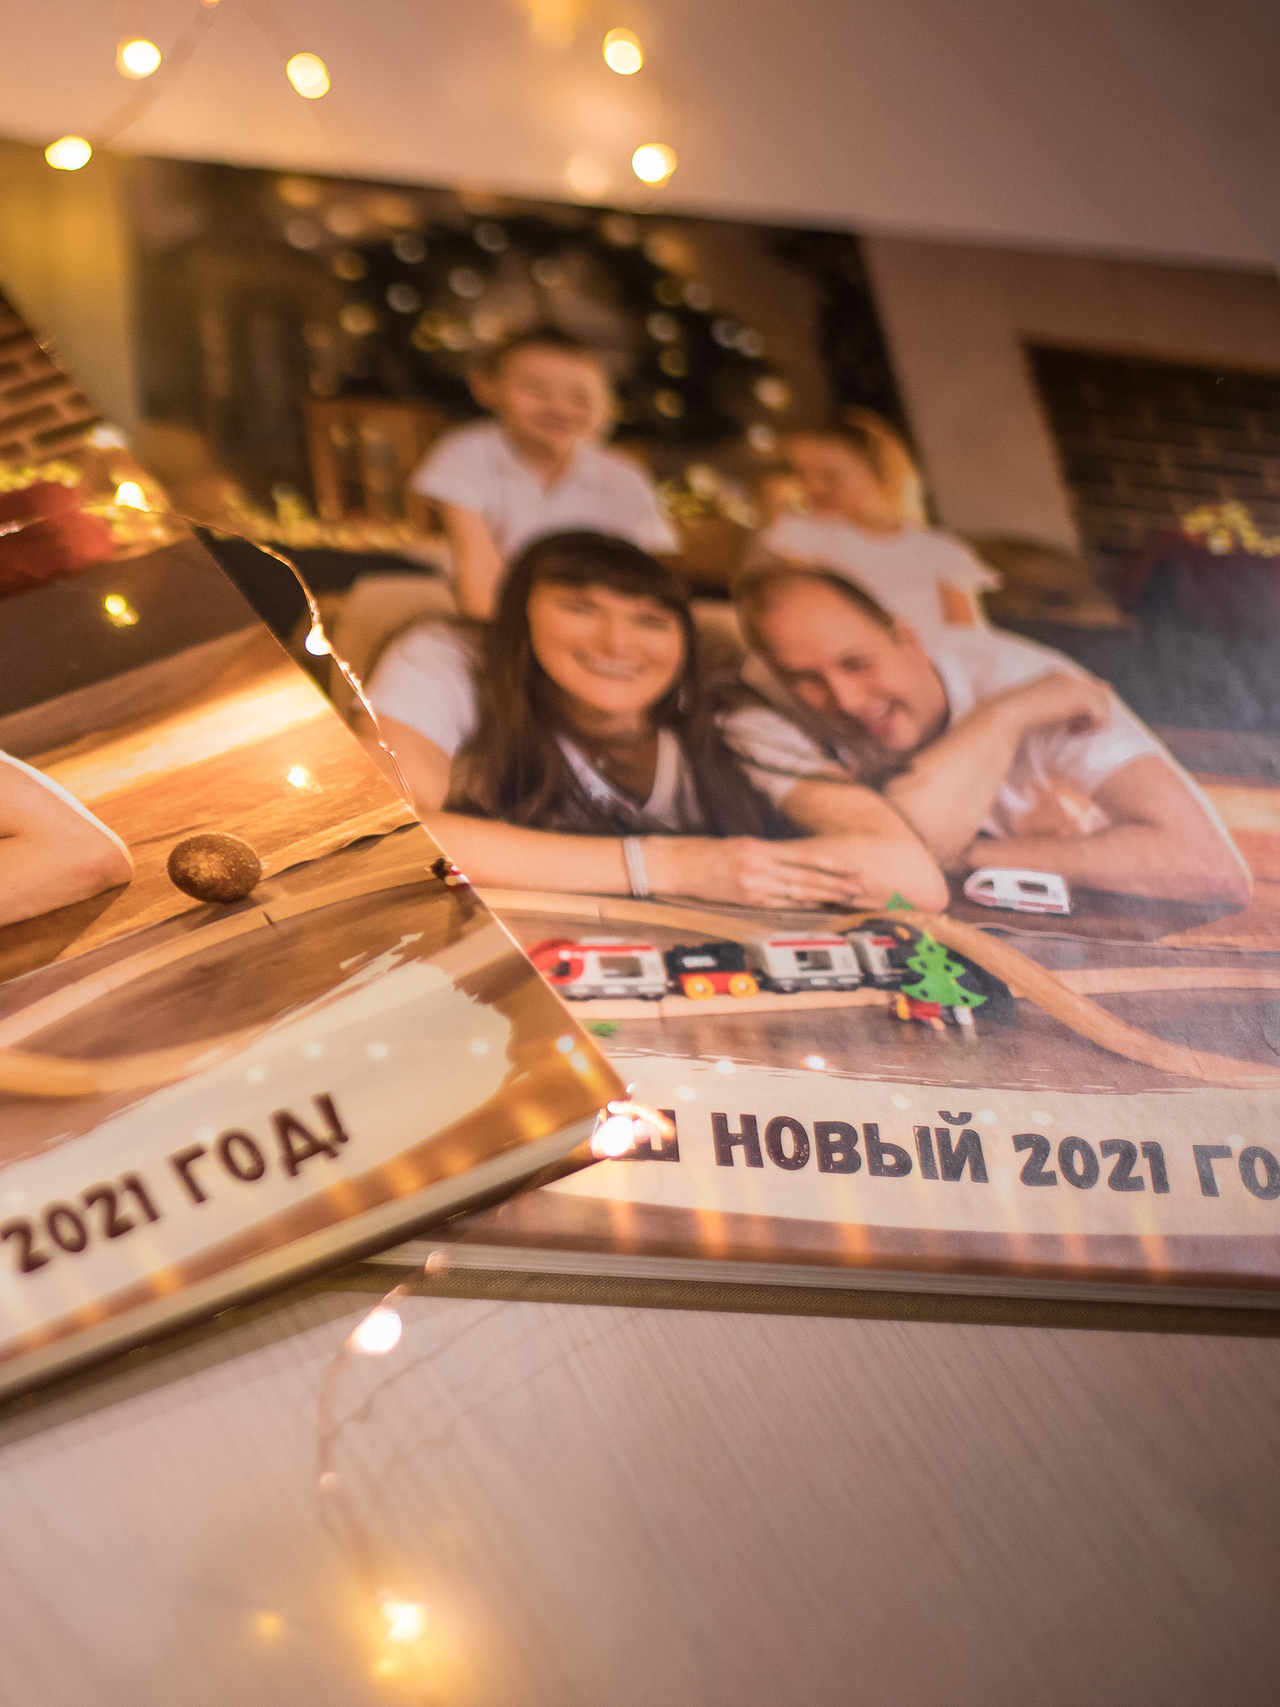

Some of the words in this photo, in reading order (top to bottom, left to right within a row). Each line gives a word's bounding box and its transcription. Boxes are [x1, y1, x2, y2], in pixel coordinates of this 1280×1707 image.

[170, 1093, 350, 1204] ГОД!
[710, 1110, 988, 1183] НОВЫЙ
[1012, 1133, 1170, 1194] 2021
